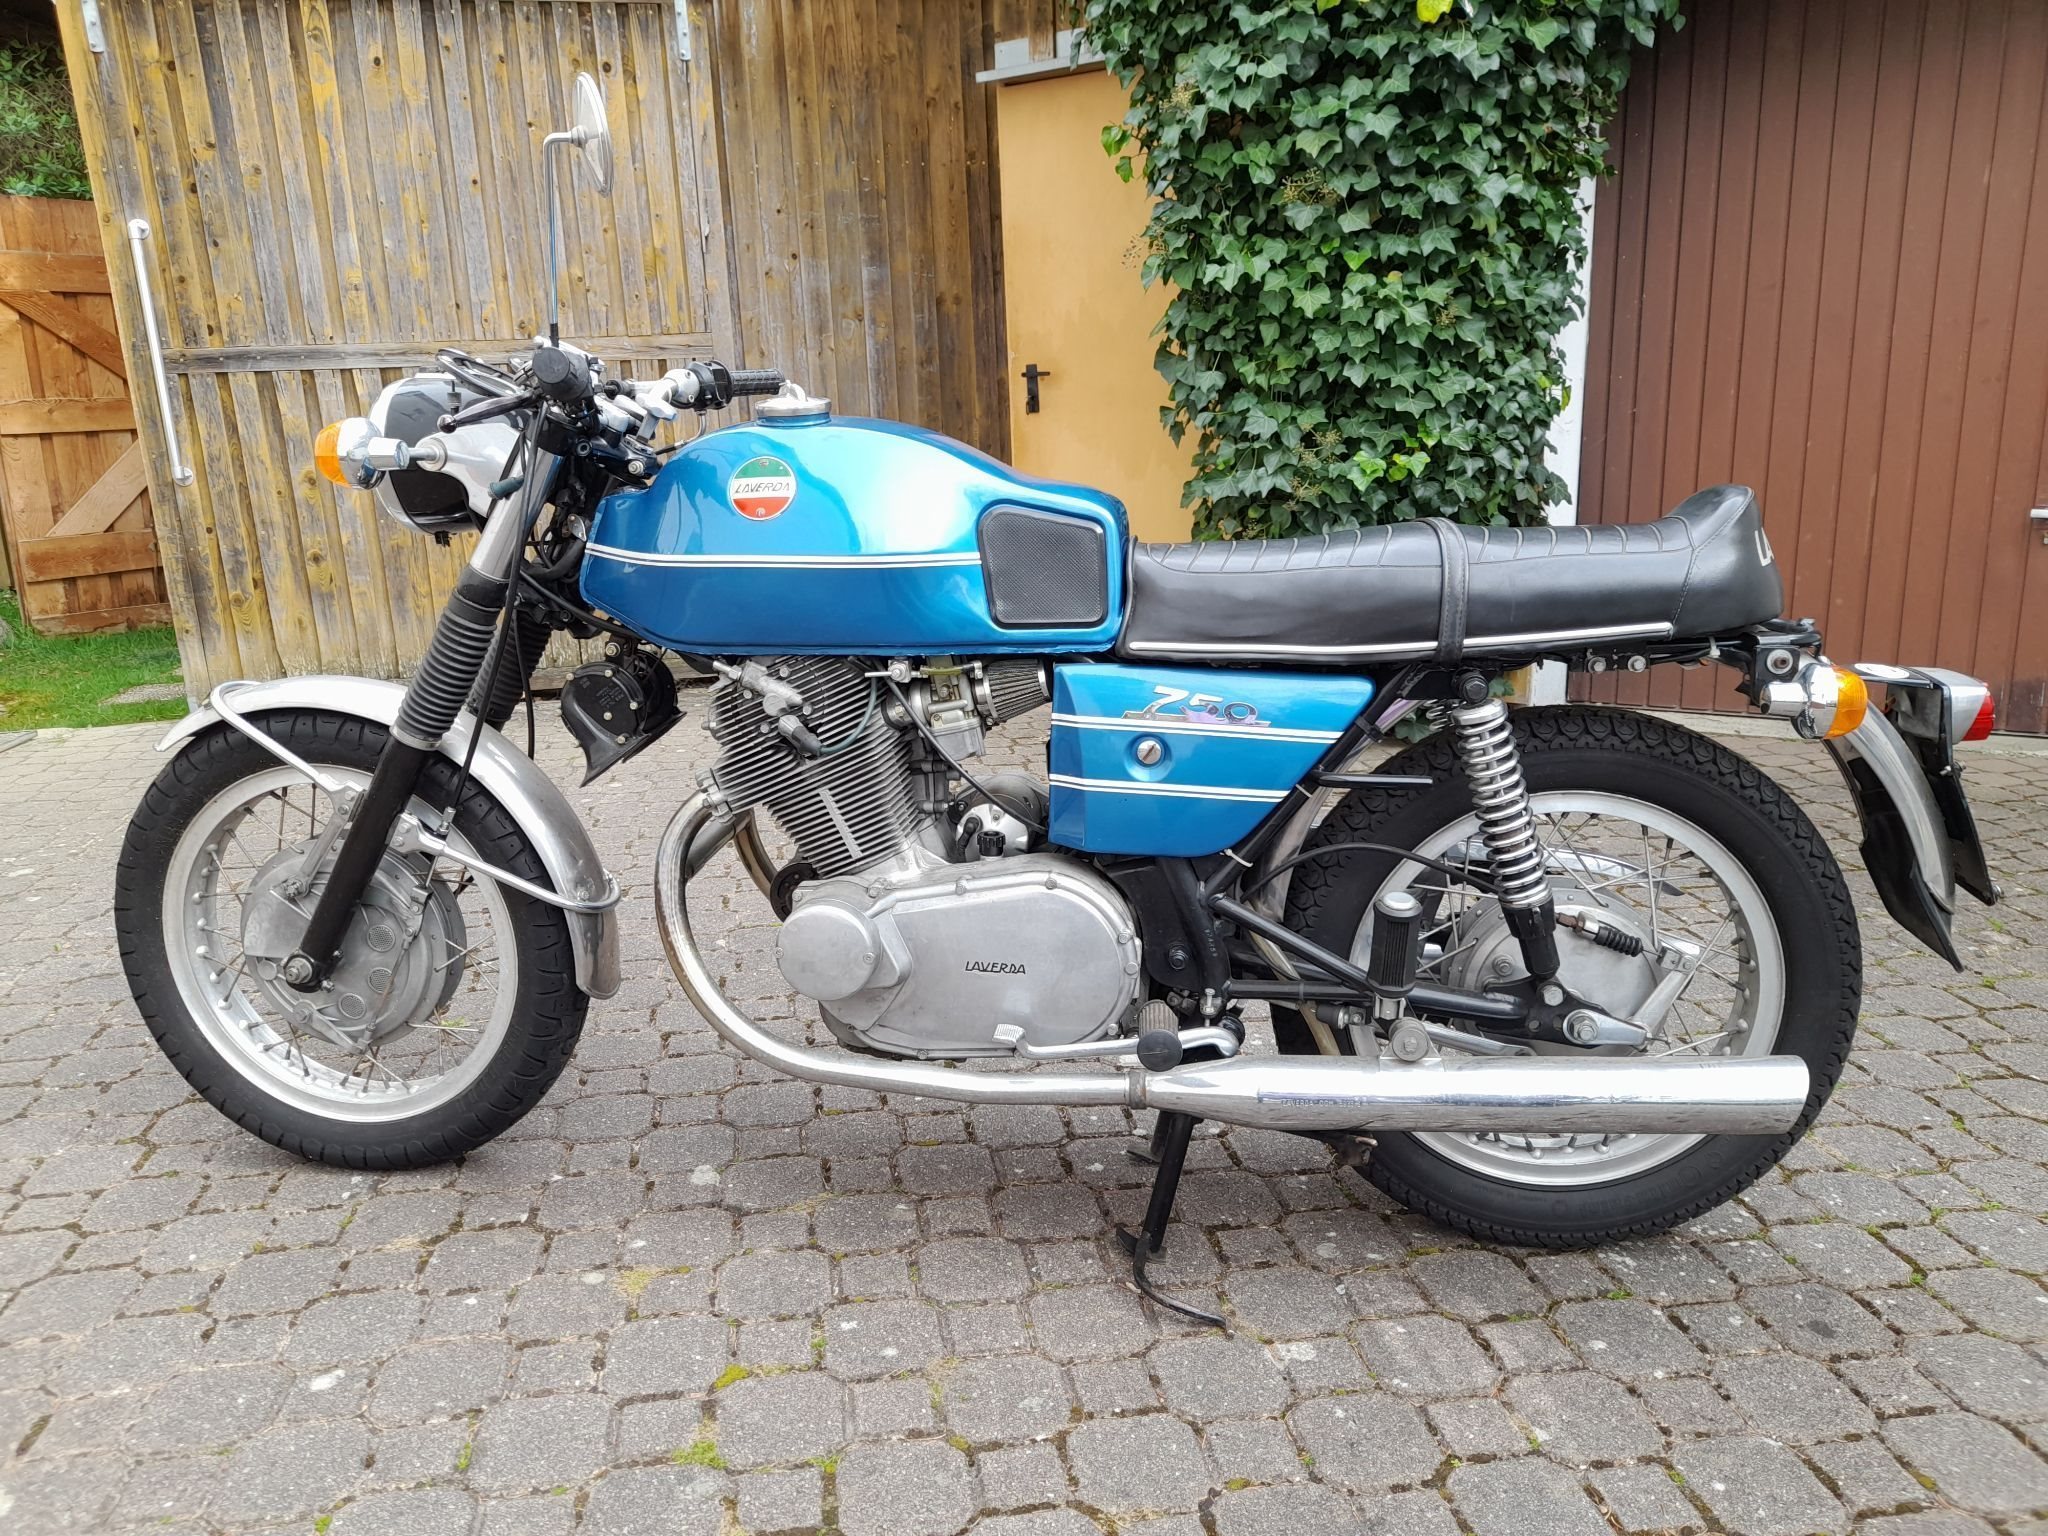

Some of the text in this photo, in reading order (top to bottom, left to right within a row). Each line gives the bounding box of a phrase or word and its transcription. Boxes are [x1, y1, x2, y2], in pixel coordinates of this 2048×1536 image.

[735, 482, 790, 494] LAVERDA
[1137, 685, 1262, 726] 750
[965, 960, 1026, 975] LAVERDA
